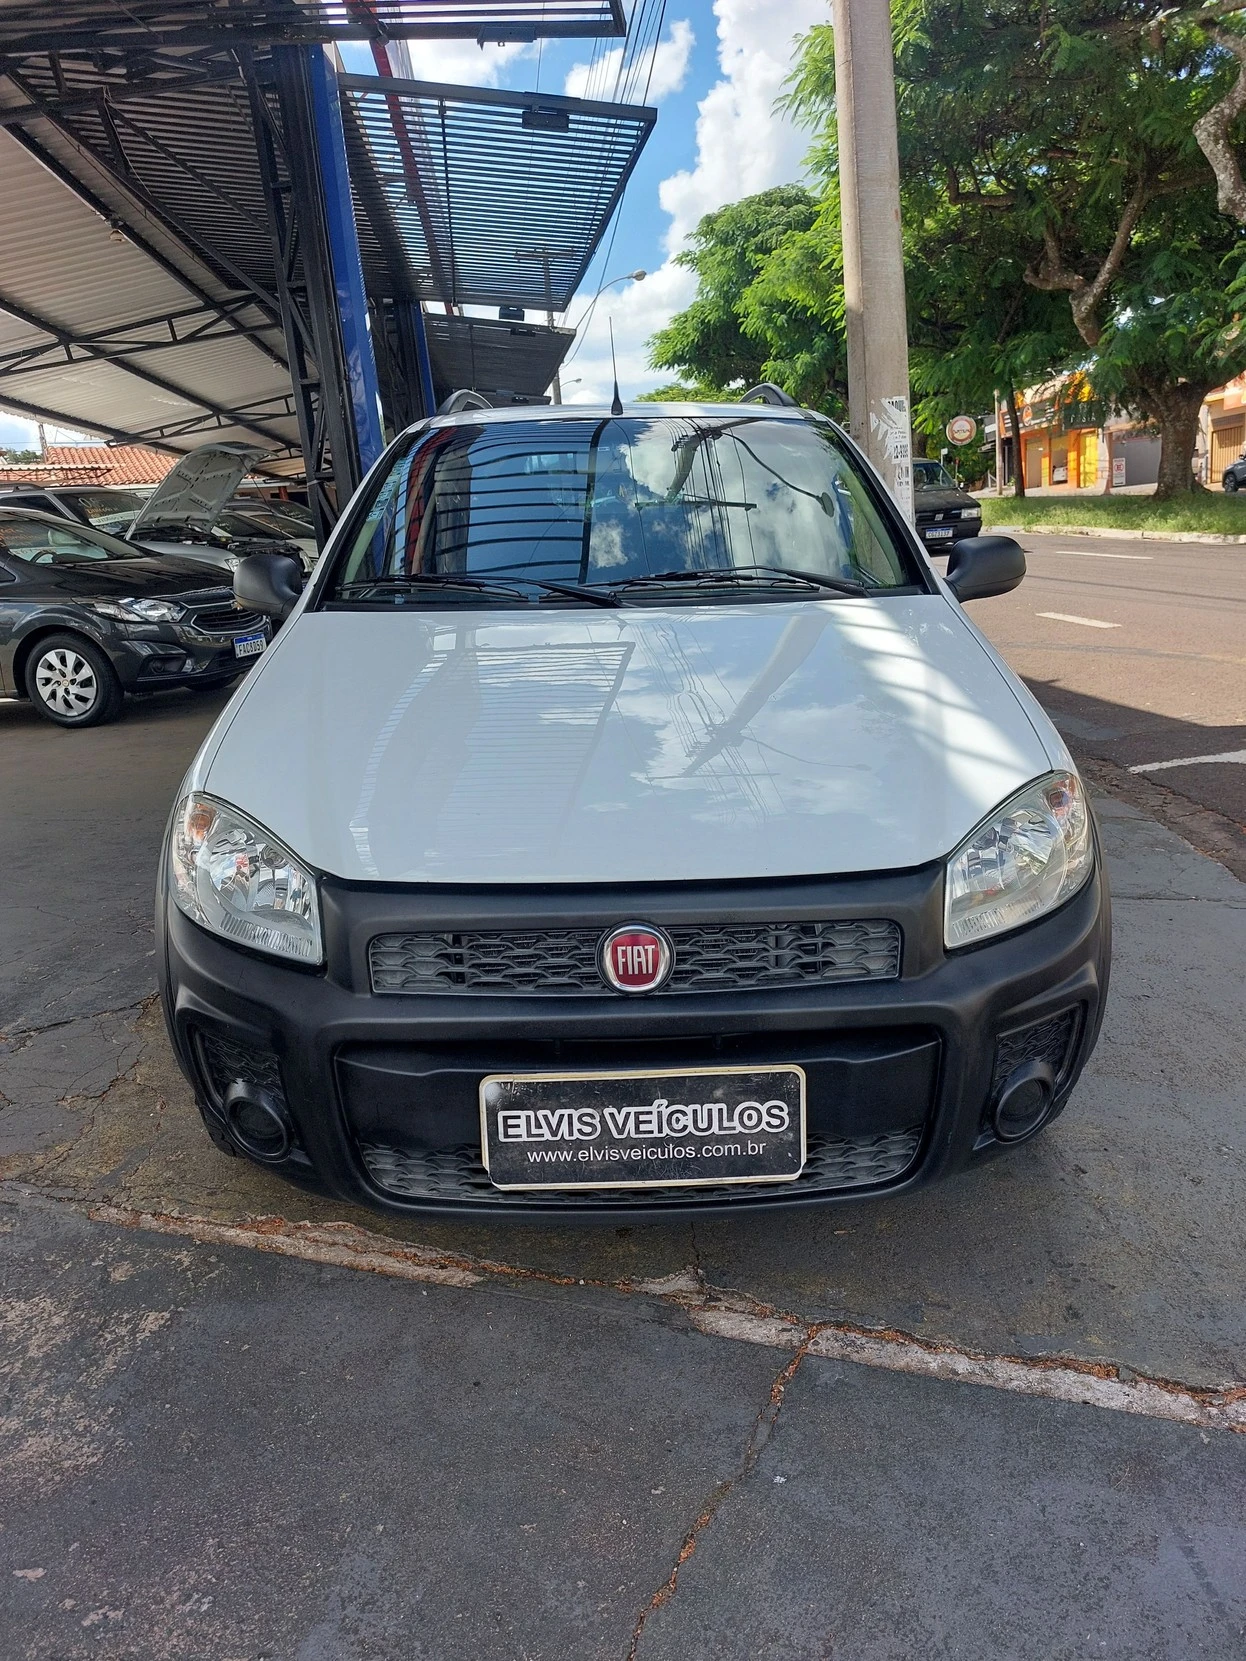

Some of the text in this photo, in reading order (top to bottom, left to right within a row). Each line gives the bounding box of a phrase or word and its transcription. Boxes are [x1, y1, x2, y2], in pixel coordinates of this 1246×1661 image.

[617, 945, 656, 975] FIAT
[498, 1099, 790, 1142] ELVIS VEÍCULOS
[527, 1139, 766, 1163] www.elvisveiculos.com.br
